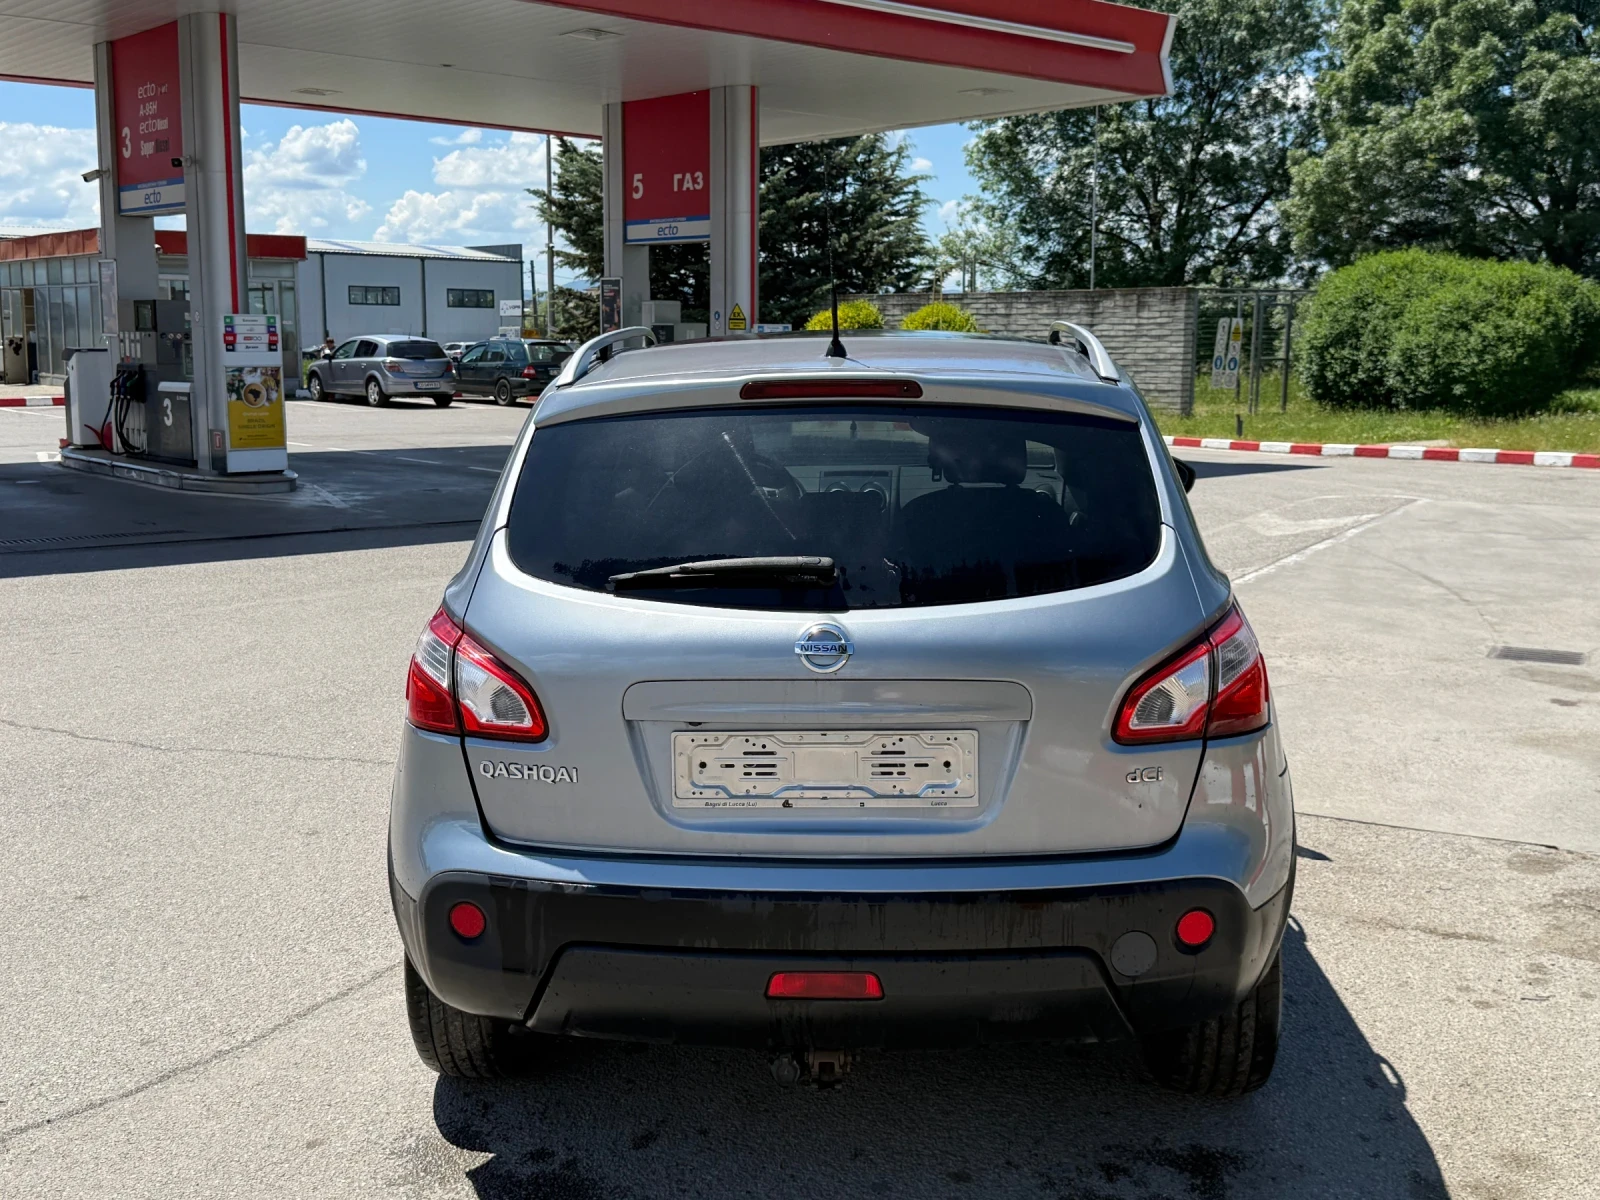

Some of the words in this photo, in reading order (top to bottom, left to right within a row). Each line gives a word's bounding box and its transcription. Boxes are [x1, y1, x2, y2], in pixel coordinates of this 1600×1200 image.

[122, 127, 132, 159] 3
[632, 173, 644, 200] 5
[673, 171, 704, 192] ГАЗ
[144, 189, 162, 205] ecto
[657, 224, 679, 236] ecto
[163, 397, 173, 427] 3
[800, 644, 848, 653] NISSAN
[479, 760, 579, 784] QASHQAI
[1126, 766, 1163, 784] dCi
